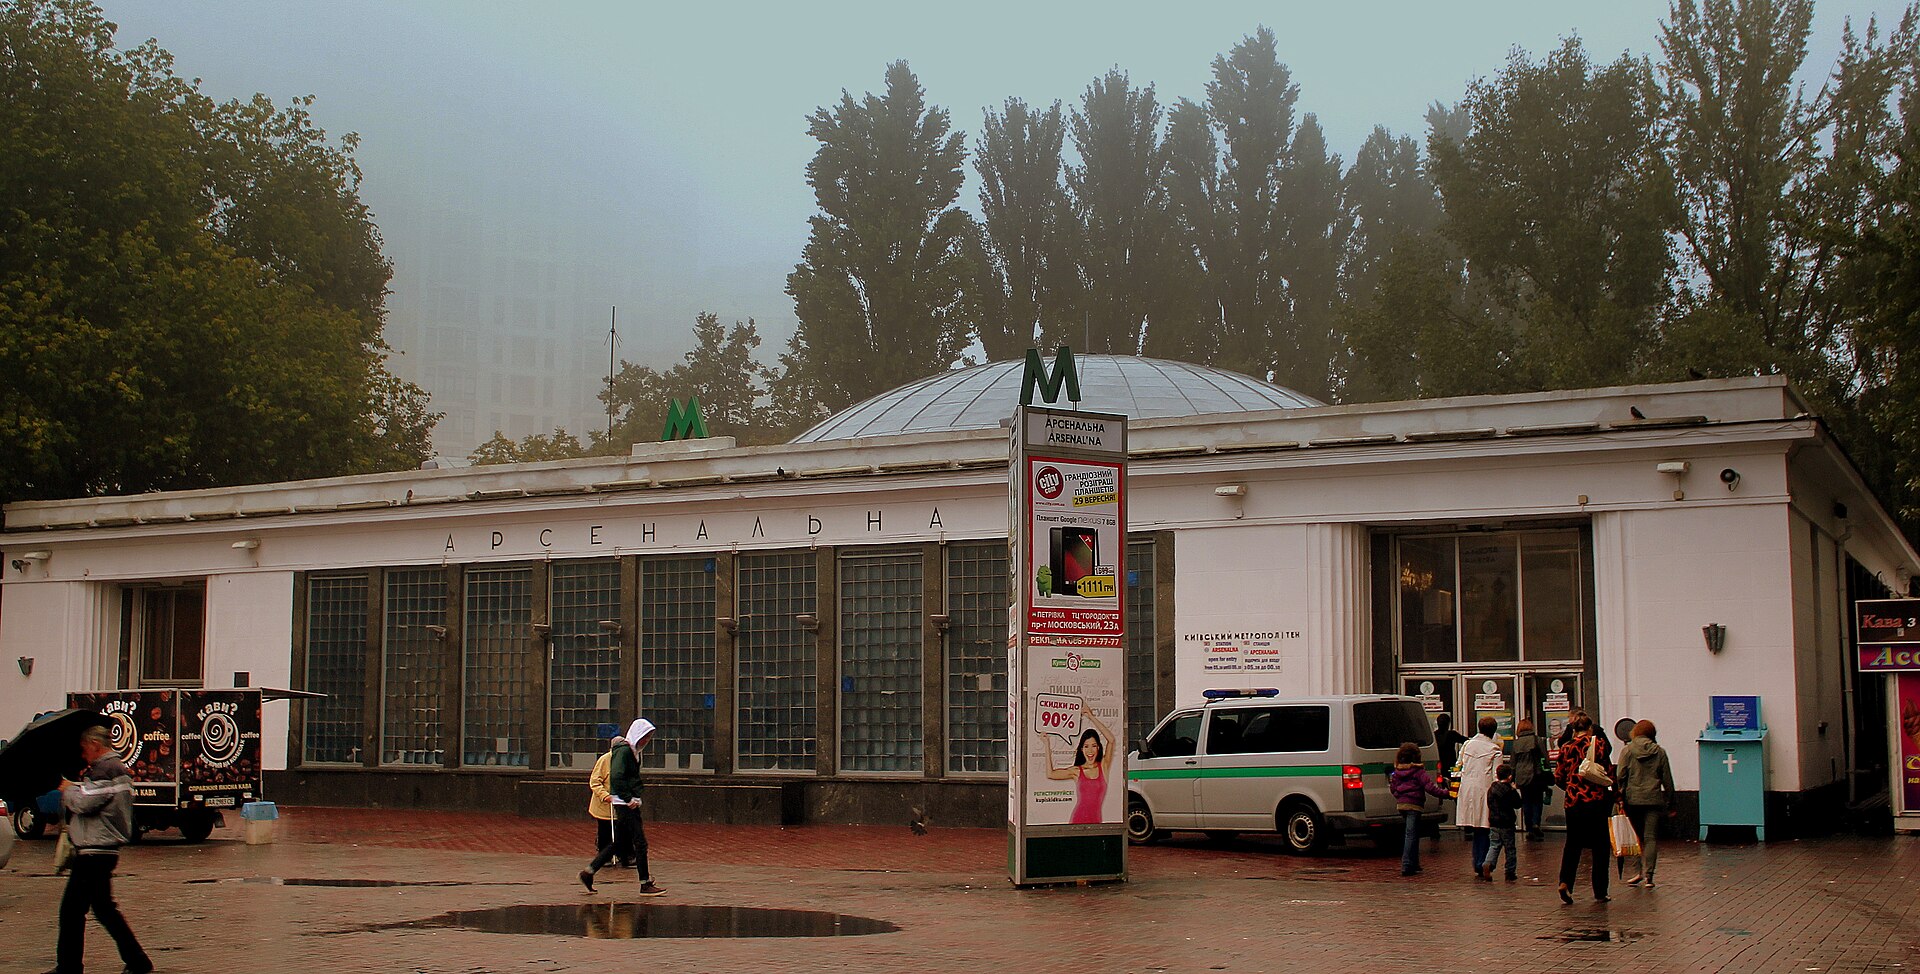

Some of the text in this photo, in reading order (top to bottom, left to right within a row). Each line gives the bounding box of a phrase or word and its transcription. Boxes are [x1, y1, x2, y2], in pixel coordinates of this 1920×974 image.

[1045, 418, 1105, 433] АРСЕНАЛЬНА
[1048, 432, 1102, 446] ARSENAL'NA
[1064, 469, 1113, 481] ГРАНДІОЗНИЙ
[1074, 493, 1116, 505] 29 ВЕРЕСНЯ!
[1060, 516, 1077, 524] Google
[445, 507, 943, 552] АРСЕНАЛЬНА
[1081, 580, 1103, 592] 1111
[1861, 614, 1903, 629] Кава
[1030, 636, 1067, 645] РЕКЛМА
[1049, 685, 1082, 695] ПИЦЦА
[1039, 700, 1080, 711] СКИДКИ ДО
[1041, 711, 1075, 729] 90%
[143, 730, 170, 741] coffee
[181, 732, 202, 740] coffee
[240, 731, 260, 739] coffee
